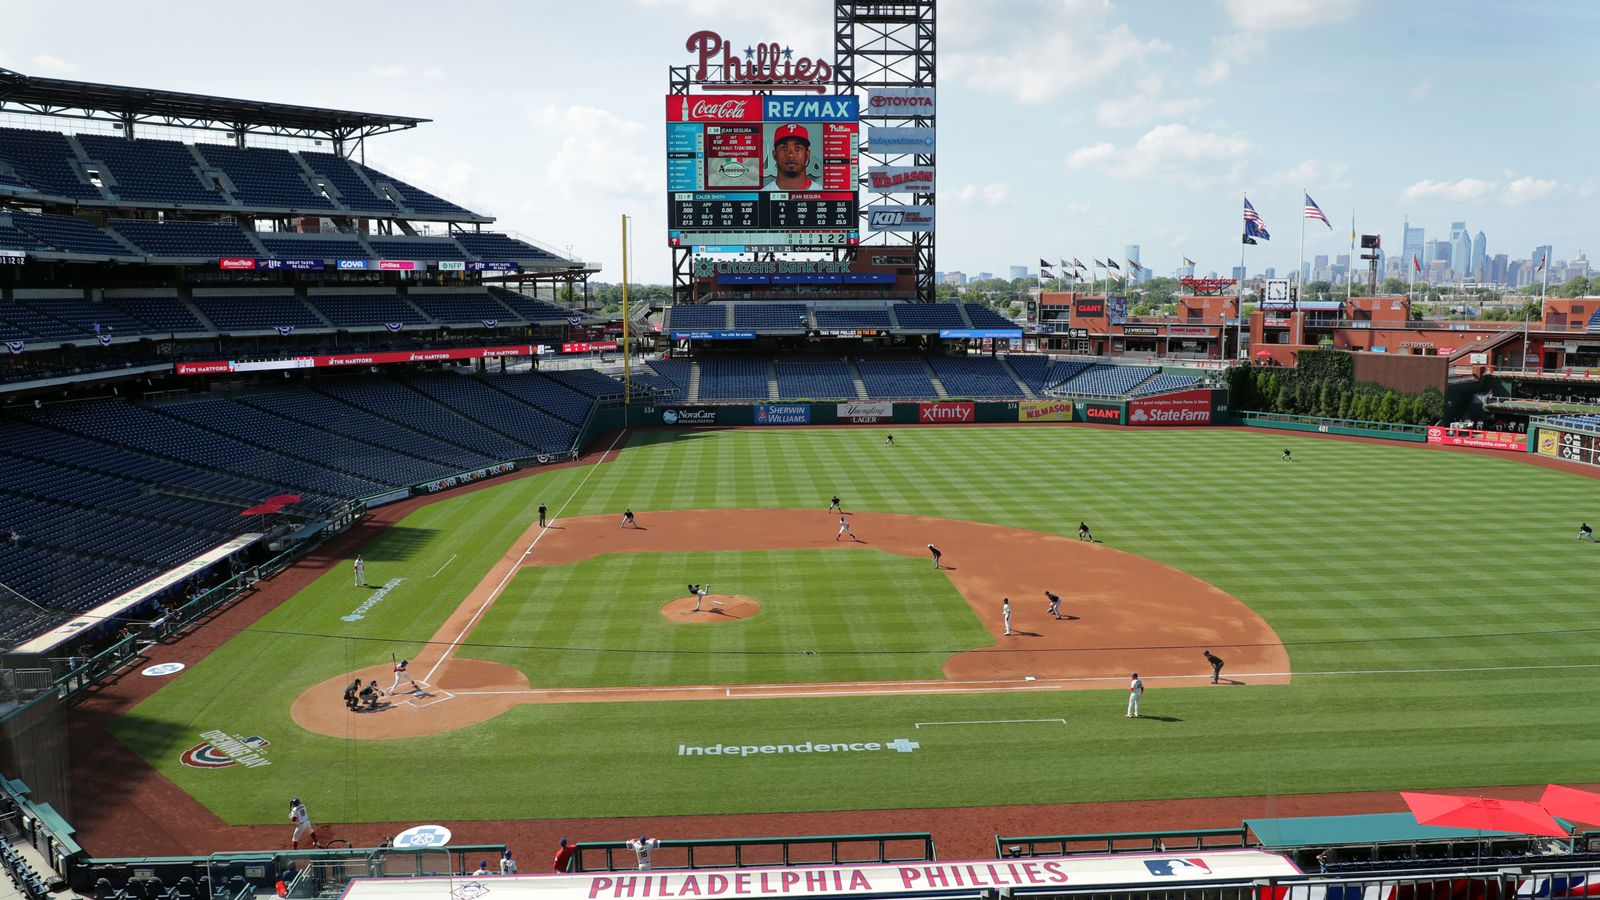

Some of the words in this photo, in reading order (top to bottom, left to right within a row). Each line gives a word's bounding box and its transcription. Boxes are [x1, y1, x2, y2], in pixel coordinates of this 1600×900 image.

[686, 30, 832, 82] Phillies
[886, 97, 932, 107] TOYOTA
[691, 100, 749, 119] Coca-Cola
[768, 102, 850, 117] RE/MAX
[829, 124, 851, 132] Phillies
[818, 234, 824, 243] 1
[828, 234, 835, 243] 2
[838, 234, 845, 243] 2
[268, 260, 281, 269] Lite
[475, 262, 485, 270] Lite
[716, 261, 777, 274] Citizens
[778, 261, 815, 274] Bank
[818, 261, 850, 274] Park
[678, 410, 716, 418] NovaCare
[768, 405, 805, 414] SHERWIN
[922, 405, 971, 421] xfinity
[1087, 408, 1120, 418] GIANT
[1463, 440, 1507, 448] buyatoyota.com
[460, 471, 488, 483] DISCOVER
[427, 478, 457, 492] DISCOVER
[200, 729, 253, 757] OPENING
[678, 741, 881, 756] Independence
[236, 753, 273, 769] DAY
[640, 850, 648, 859] 15
[588, 868, 873, 899] PHILADELPHIA
[900, 861, 1070, 889] PHILLIES
